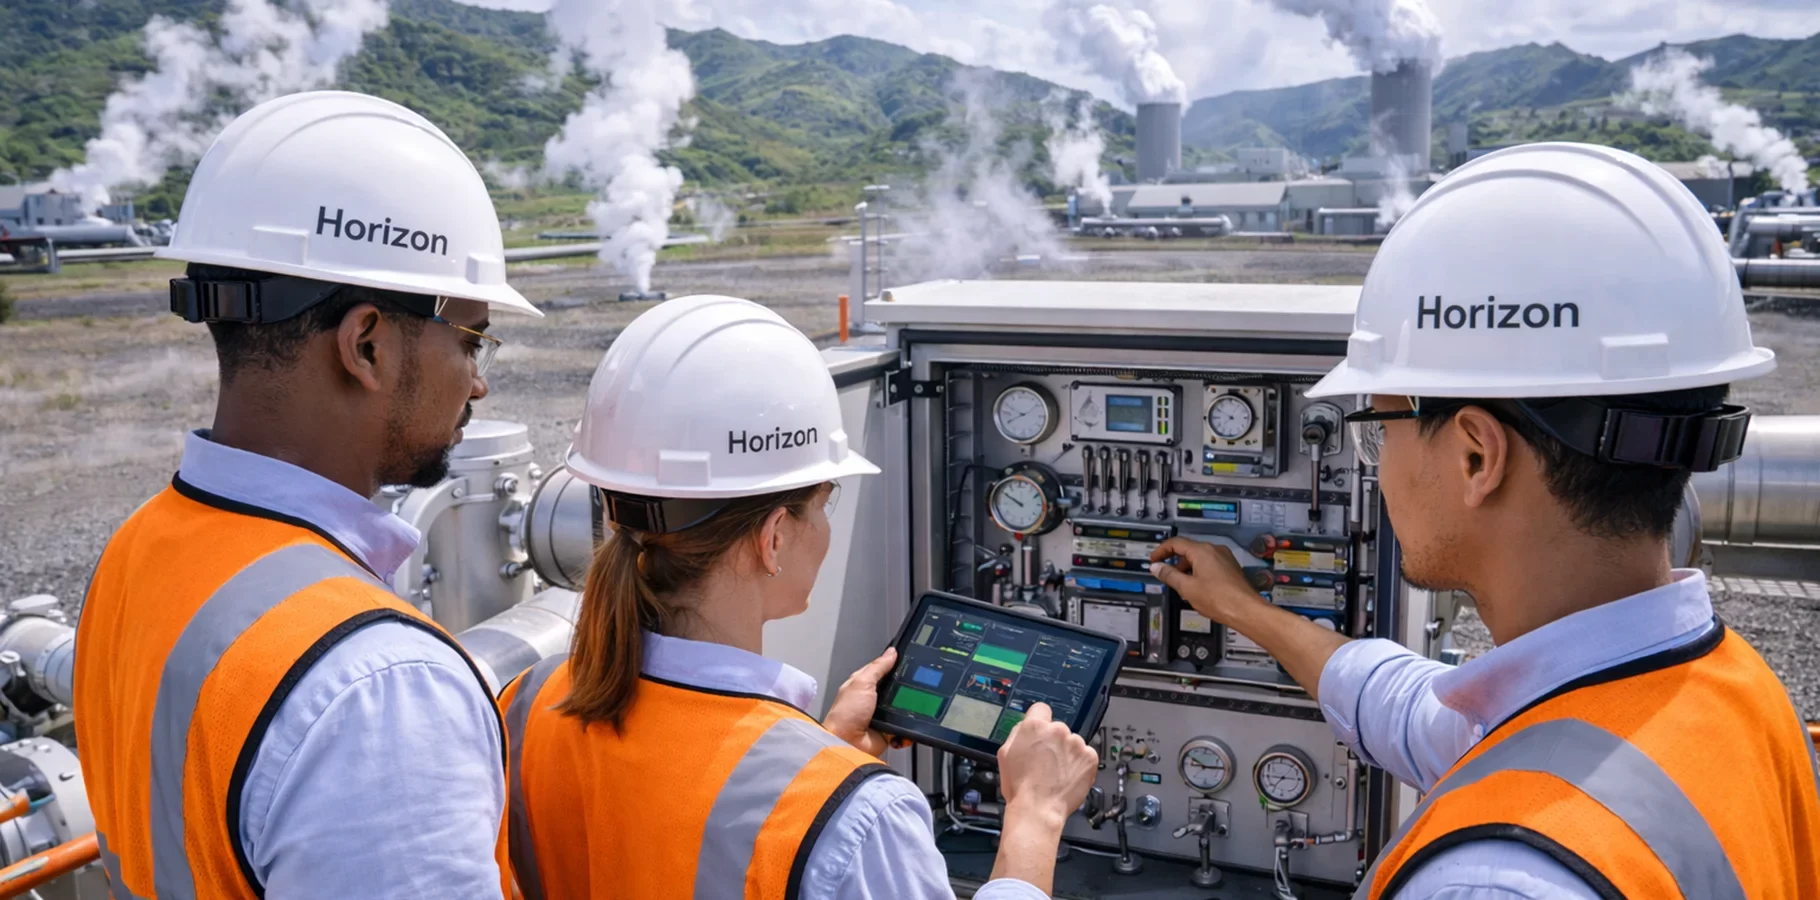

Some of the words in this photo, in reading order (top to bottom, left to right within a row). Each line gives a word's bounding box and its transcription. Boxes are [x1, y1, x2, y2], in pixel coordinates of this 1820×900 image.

[316, 206, 447, 255] Horizon
[1418, 296, 1579, 329] Horizon
[729, 427, 817, 454] Horizon
